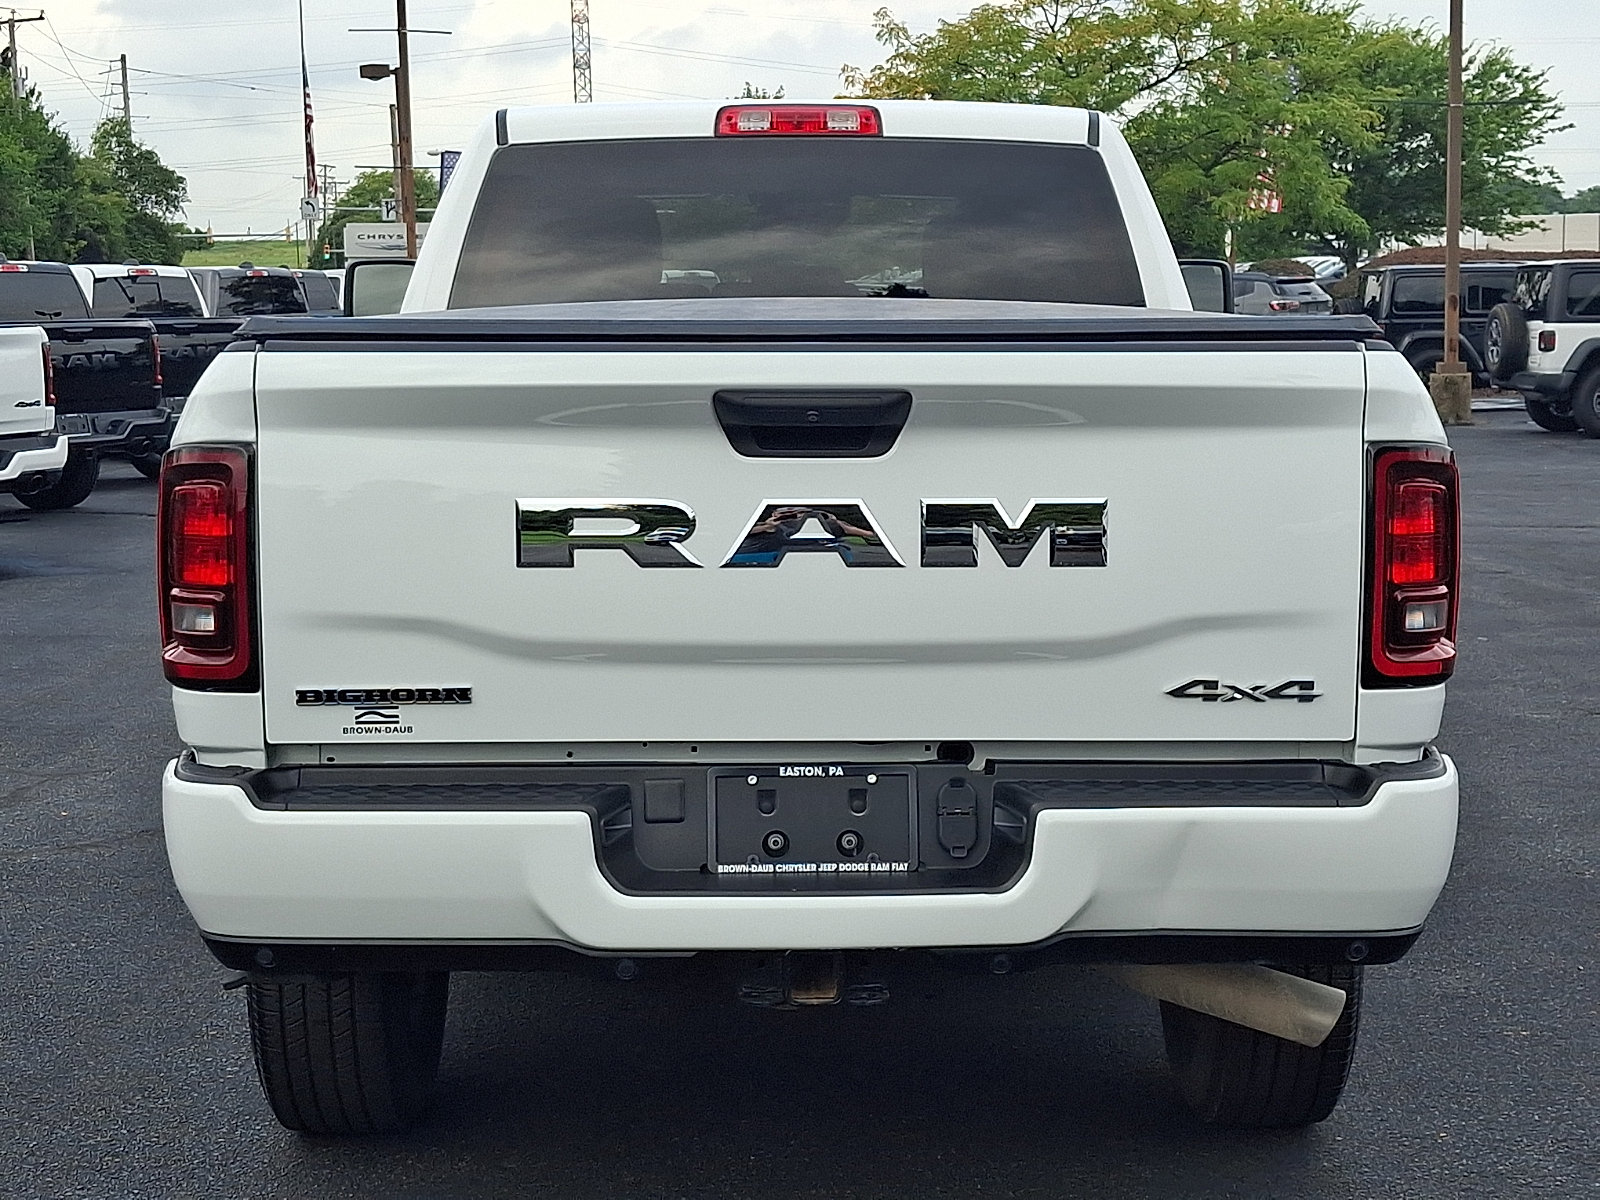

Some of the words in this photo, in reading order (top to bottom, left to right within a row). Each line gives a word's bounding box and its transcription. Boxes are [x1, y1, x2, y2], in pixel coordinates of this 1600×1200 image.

[515, 498, 1109, 568] RAM
[296, 687, 472, 706] BIGHORN
[1164, 679, 1323, 703] 4x4
[342, 726, 413, 735] BROWN-DAUB
[779, 766, 825, 777] EASTON,
[828, 766, 844, 776] PA
[717, 863, 774, 873] BROWN-DAUB
[776, 863, 817, 873] CHRYSLER
[818, 863, 837, 873] JEEP
[839, 863, 869, 873] DODGE
[871, 863, 889, 873] RAM
[891, 863, 908, 873] FIAT
